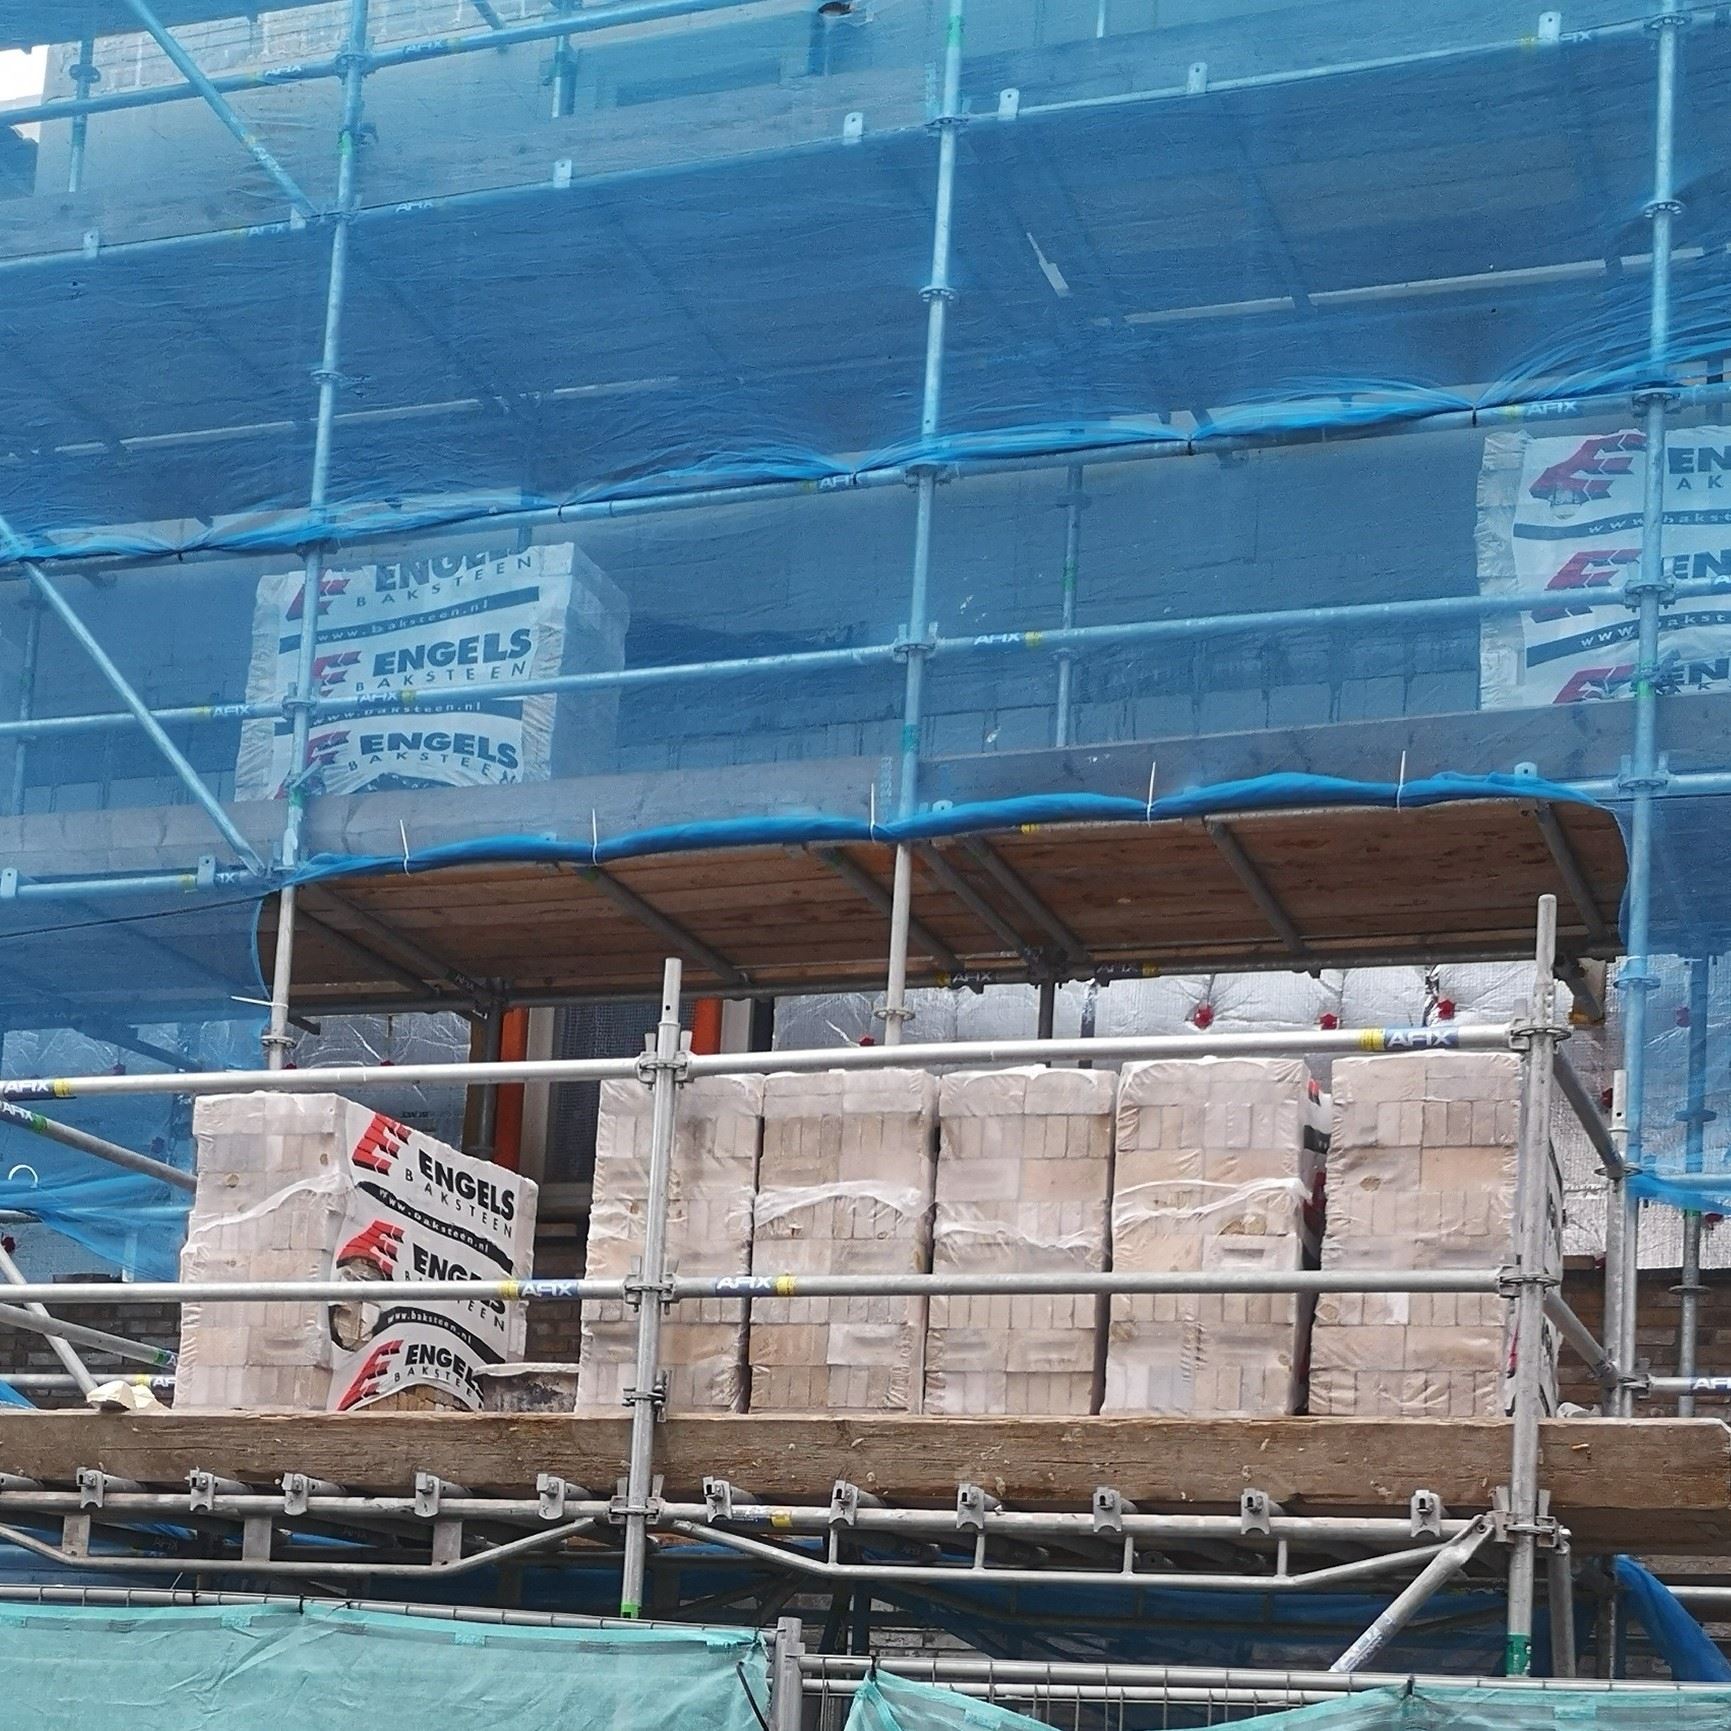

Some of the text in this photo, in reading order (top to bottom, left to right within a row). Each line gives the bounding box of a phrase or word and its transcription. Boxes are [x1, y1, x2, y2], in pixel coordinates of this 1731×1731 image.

[1526, 401, 1578, 416] AFIX
[356, 556, 532, 608] BAKSTEEN
[973, 632, 1021, 645] AFIX
[372, 628, 532, 677] ENGELS
[355, 660, 526, 692] BAKSTEEN
[359, 691, 398, 703] AFIX
[212, 704, 251, 718] AFIX
[359, 732, 519, 770] ENGELS
[1387, 1029, 1456, 1048] AFIX
[4, 1079, 50, 1094] AFIX
[2, 1100, 34, 1122] AFIX
[418, 1148, 515, 1221] ENGELS
[405, 1168, 512, 1238] BAKSTEEN
[520, 1280, 574, 1298] AFIX
[716, 1275, 773, 1290] AFIX
